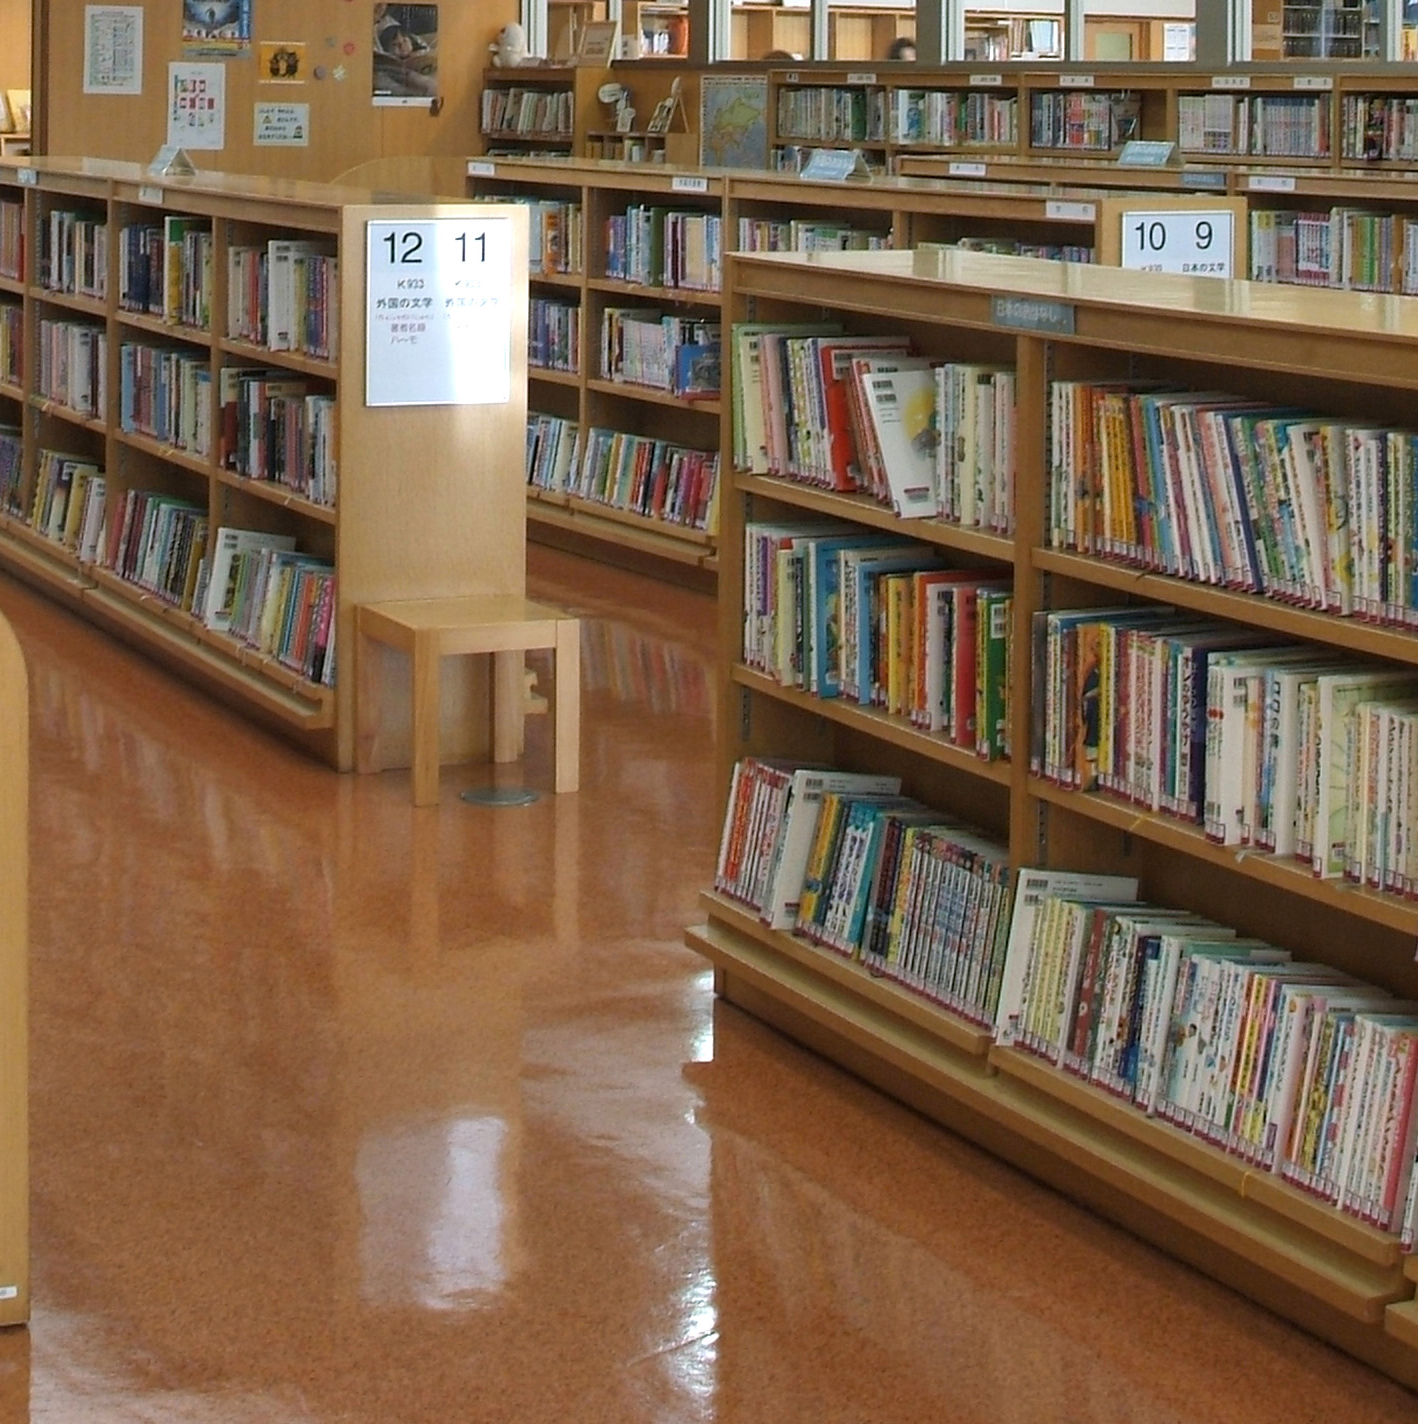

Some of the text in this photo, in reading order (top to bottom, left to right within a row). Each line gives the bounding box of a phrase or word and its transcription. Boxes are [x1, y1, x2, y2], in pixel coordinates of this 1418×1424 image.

[383, 231, 423, 264] 12
[454, 231, 486, 263] 11
[1135, 221, 1166, 251] 10
[1195, 221, 1213, 250] 9
[1182, 262, 1226, 273] 日本の文学
[396, 278, 425, 290] K933
[376, 296, 433, 309] 外国の文学
